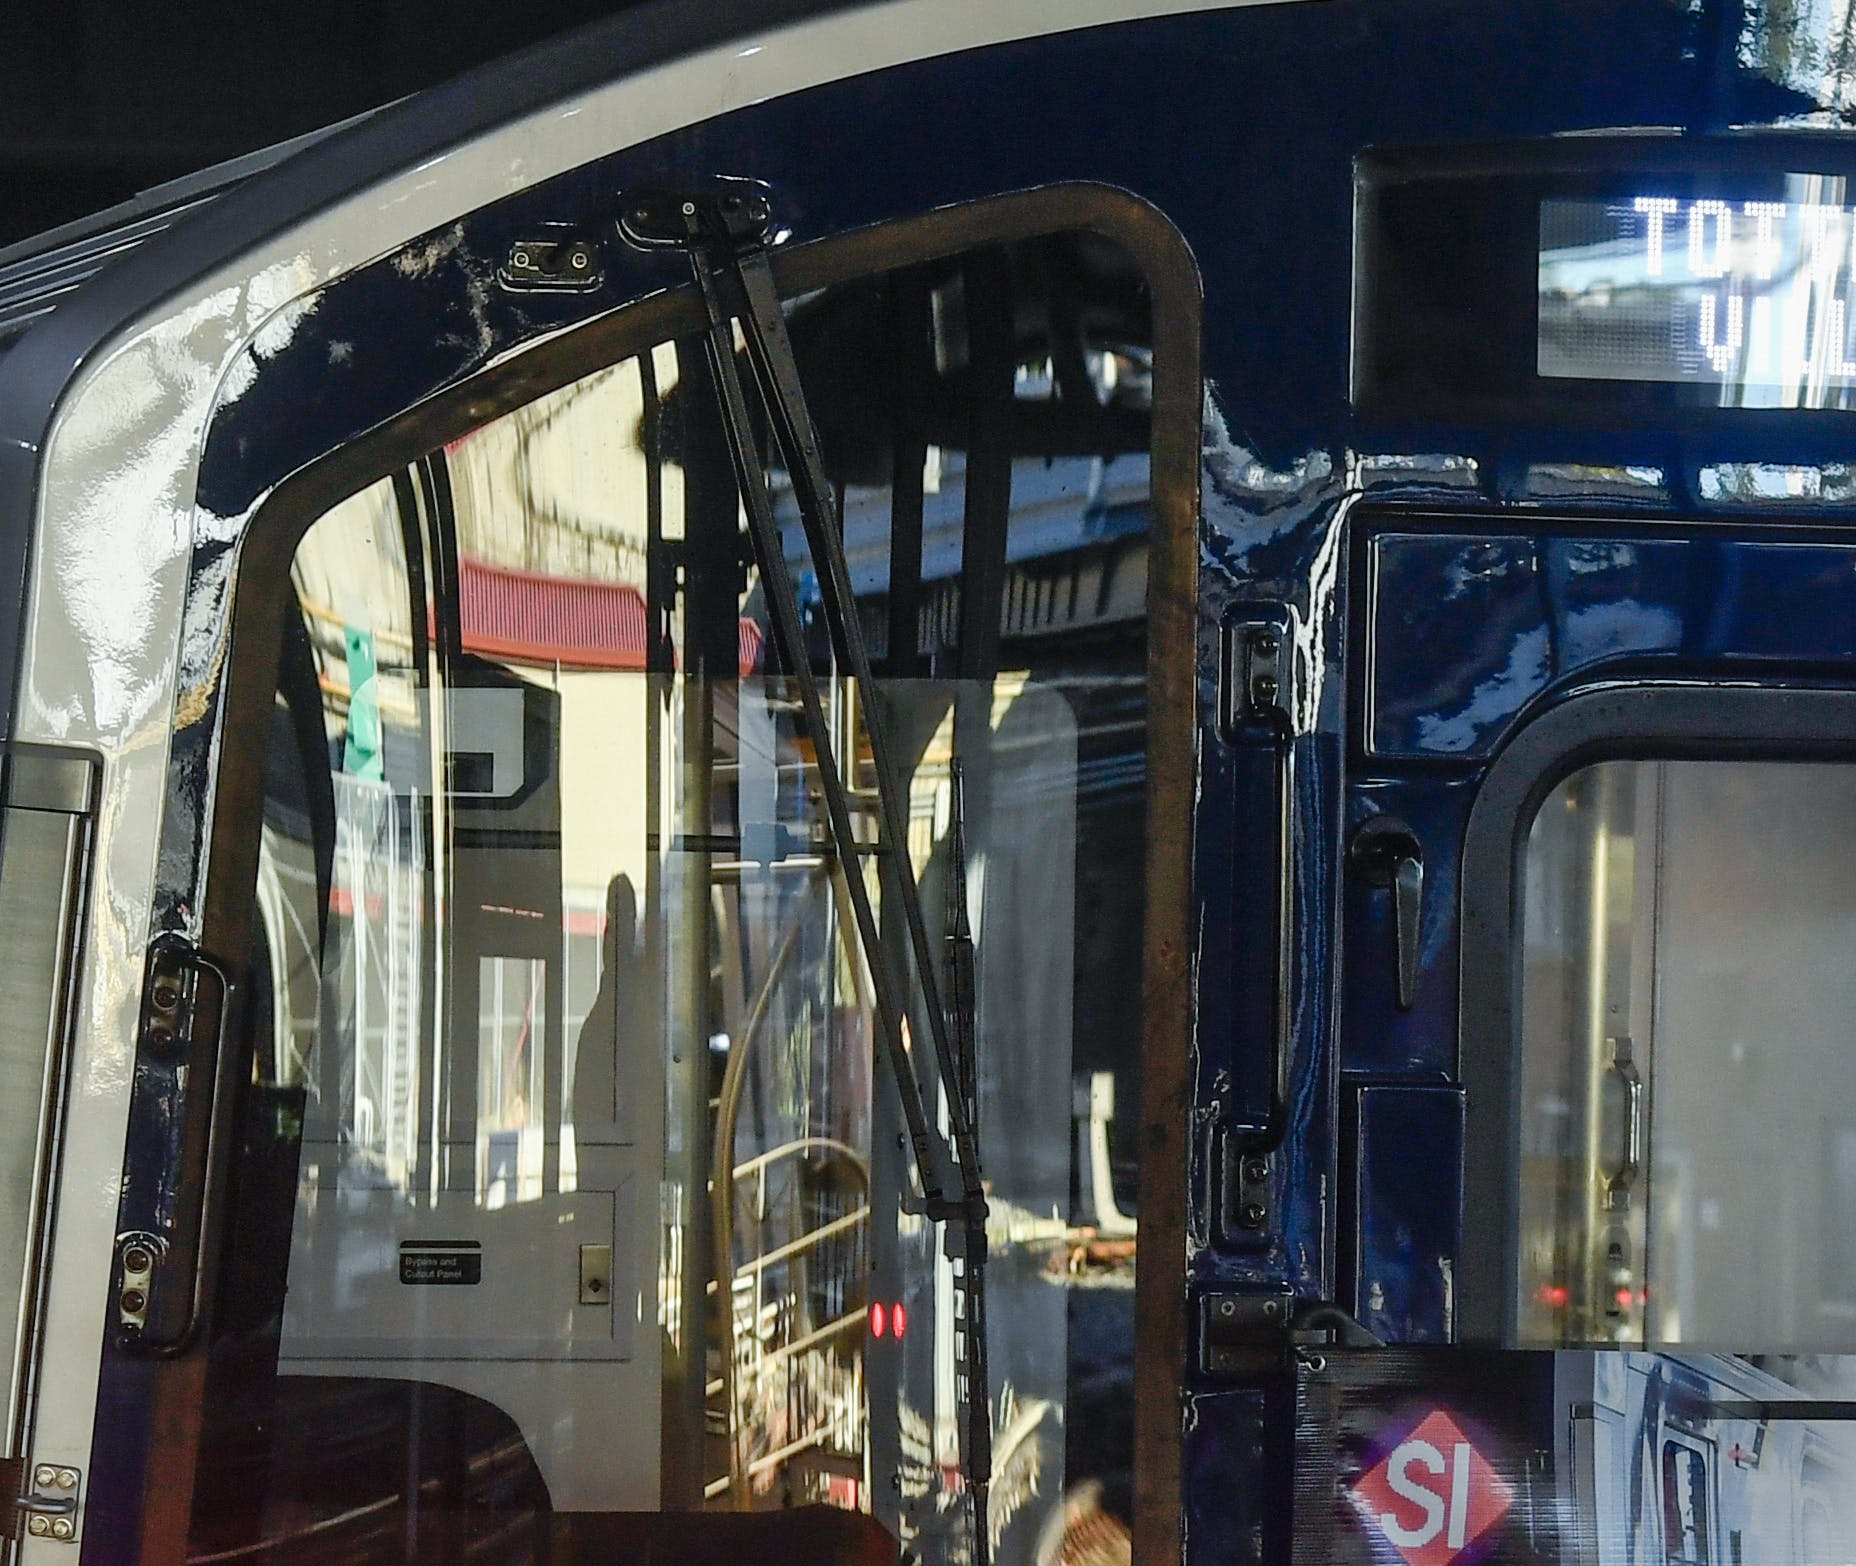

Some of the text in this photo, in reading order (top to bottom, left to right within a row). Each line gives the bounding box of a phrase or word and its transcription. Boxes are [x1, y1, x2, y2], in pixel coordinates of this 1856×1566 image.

[404, 1256, 457, 1268] Bypass and
[436, 1268, 463, 1279] Panel
[1380, 1440, 1471, 1548] SI
